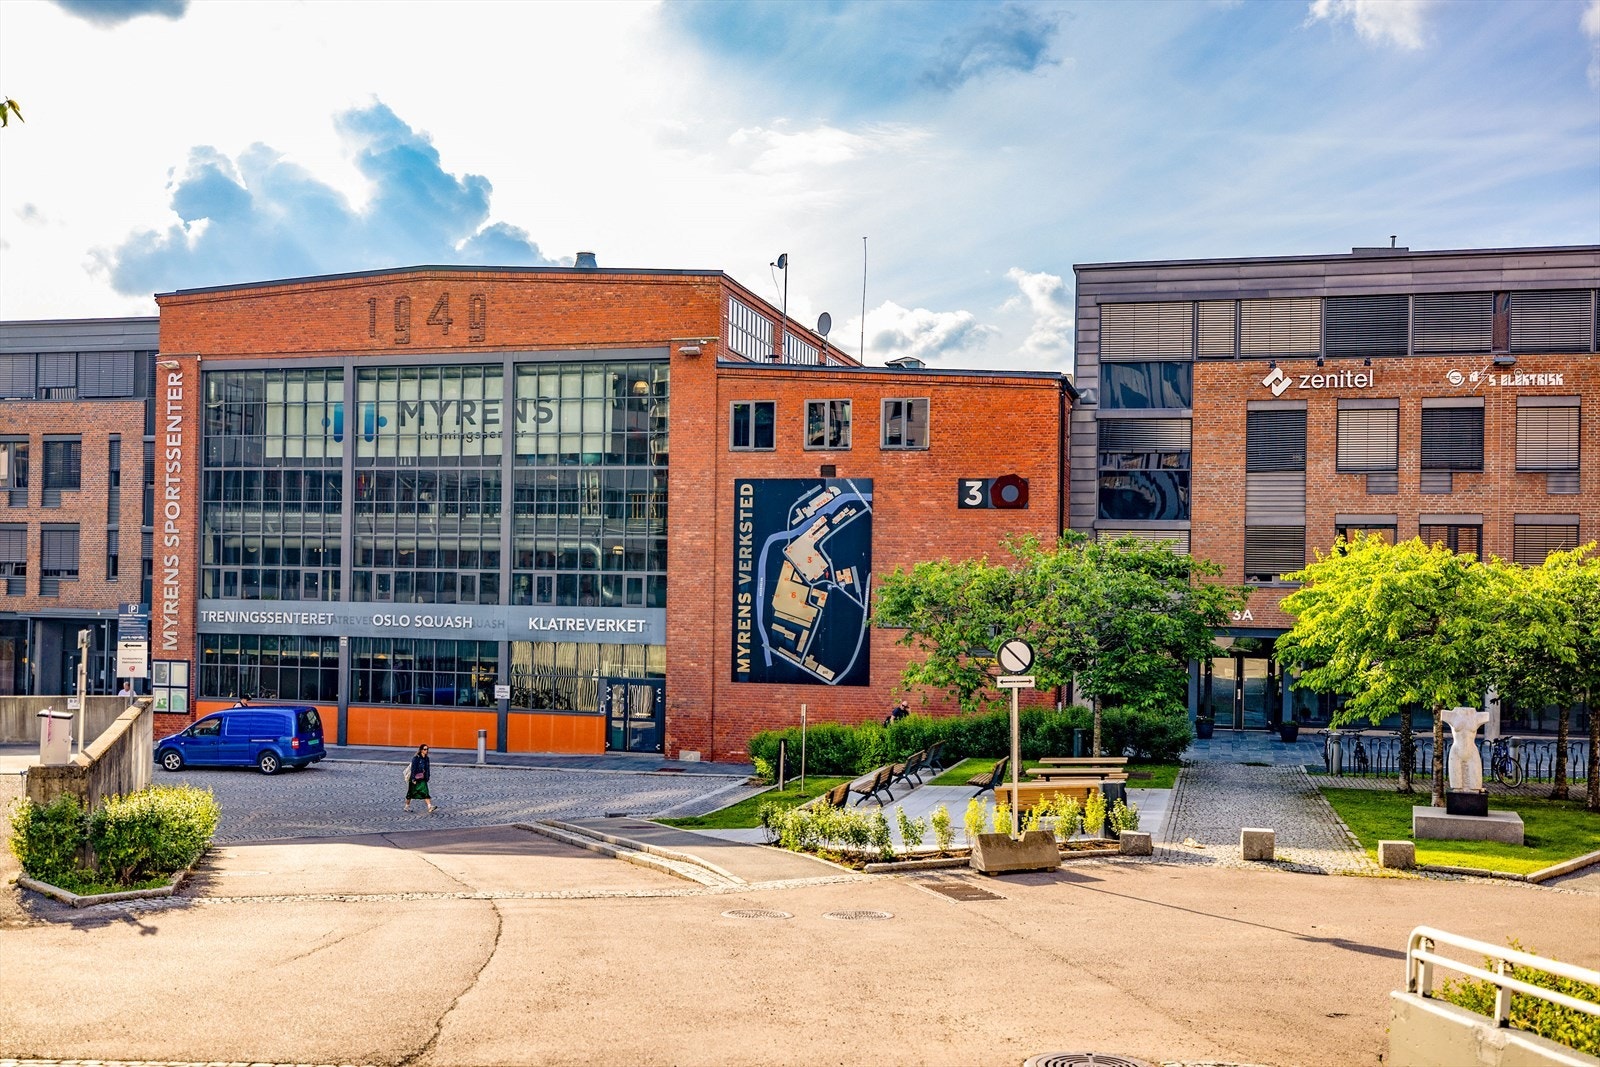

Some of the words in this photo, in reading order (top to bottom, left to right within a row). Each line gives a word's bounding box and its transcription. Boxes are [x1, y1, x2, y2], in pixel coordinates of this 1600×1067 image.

[367, 292, 486, 344] 1949
[1299, 369, 1374, 389] zenitel
[1500, 373, 1563, 386] ELEKTRISK
[400, 396, 553, 427] MYRENS
[164, 372, 183, 548] SPORTSSENTER
[738, 483, 754, 586] VERKSTED
[807, 556, 813, 564] 3
[162, 554, 180, 651] MYRENS
[820, 593, 826, 601] 2
[201, 610, 334, 625] TRENINGSSENTERET
[372, 614, 411, 627] OSLO
[414, 615, 473, 629] SQUASH
[1232, 610, 1254, 621] 3A
[528, 617, 646, 633] KLATREVERKET
[736, 592, 752, 673] MYRENS
